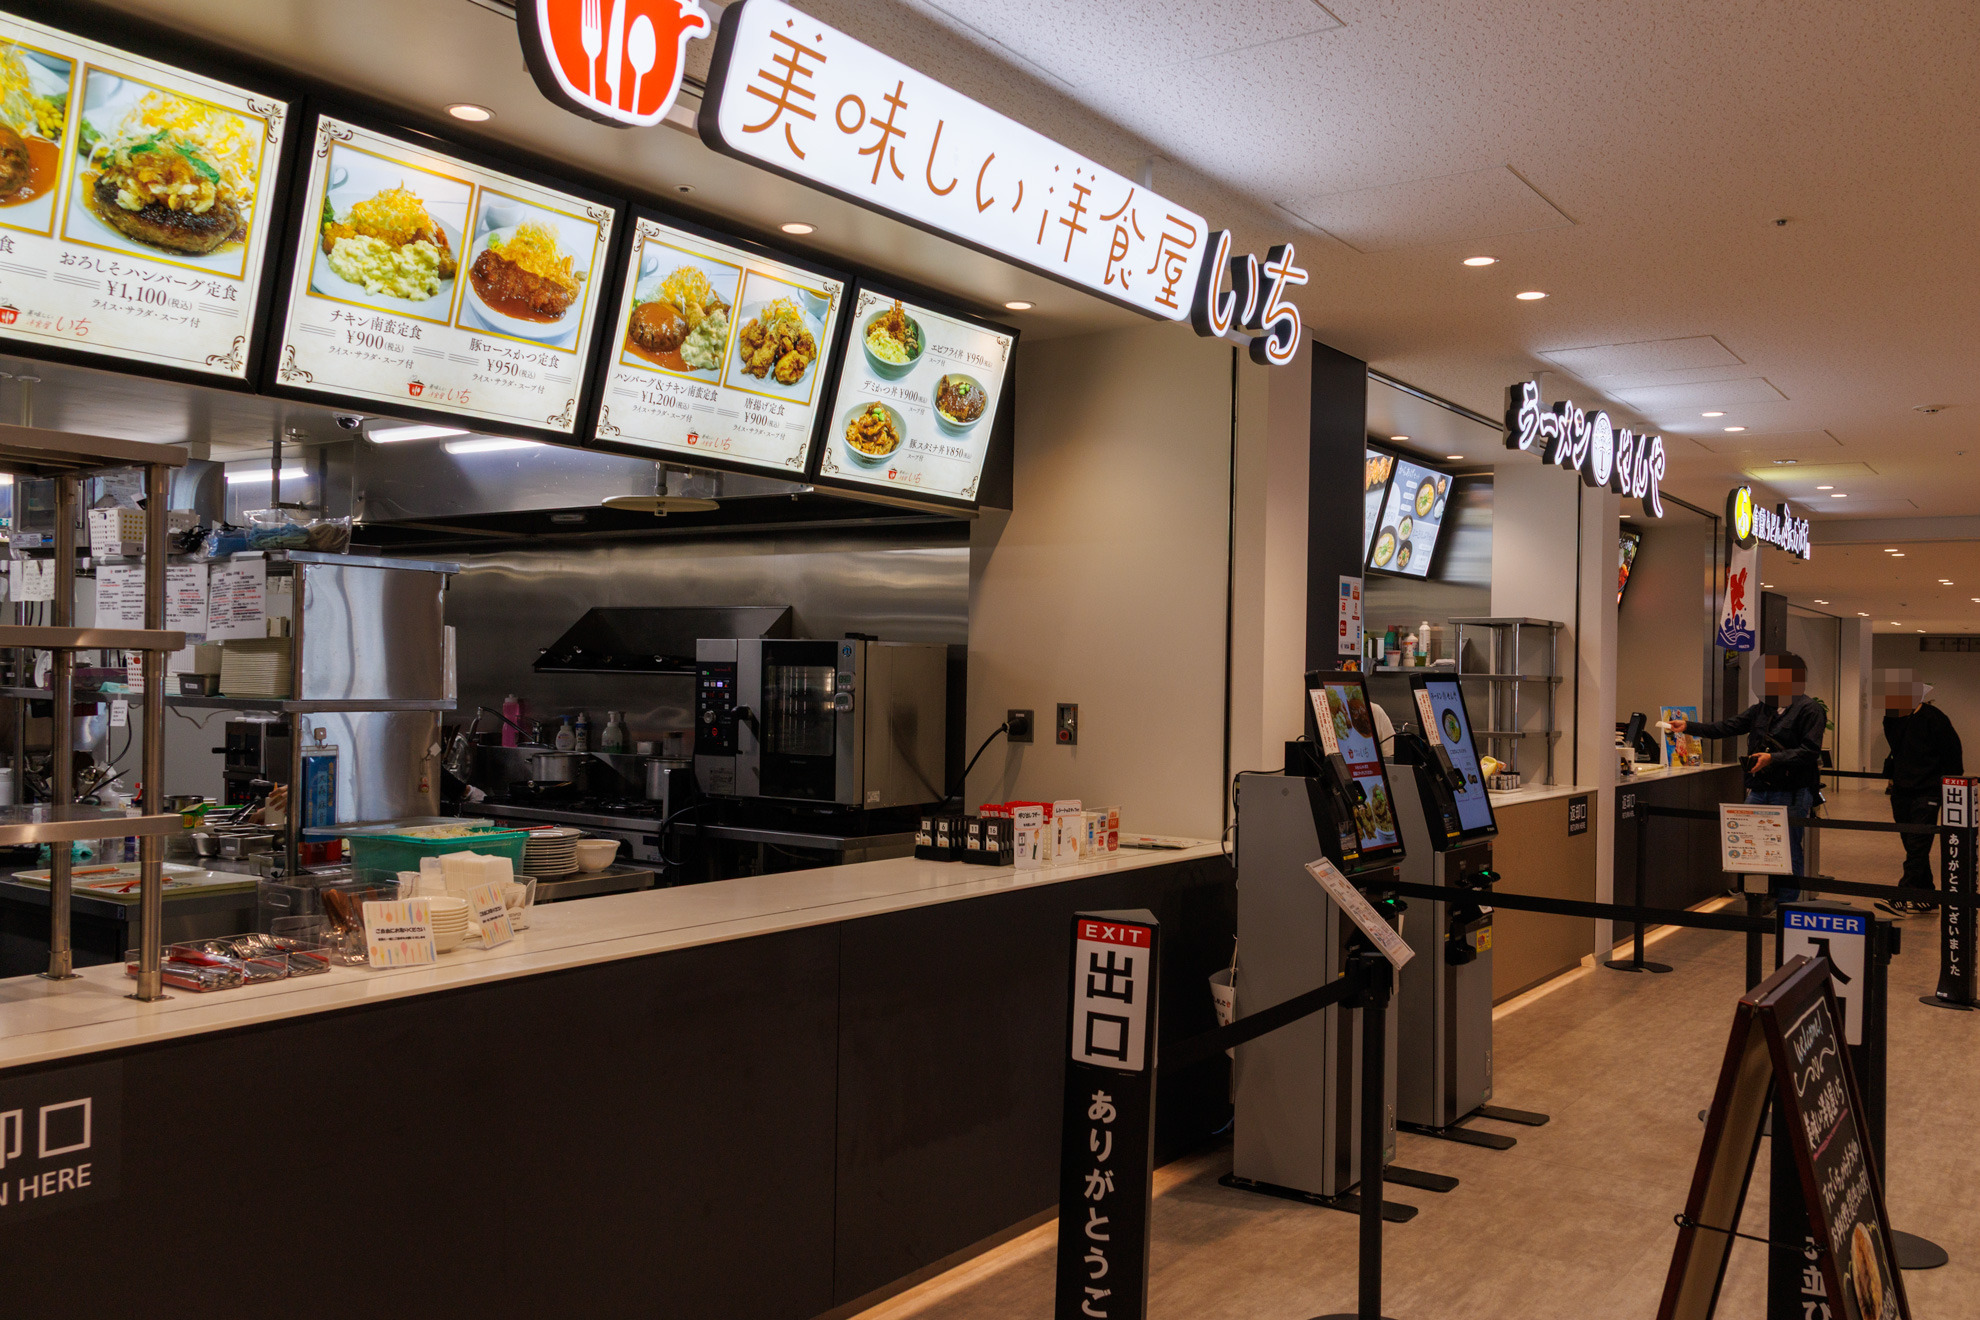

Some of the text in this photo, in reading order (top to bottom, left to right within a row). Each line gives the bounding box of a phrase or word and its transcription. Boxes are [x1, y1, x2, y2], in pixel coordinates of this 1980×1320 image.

[742, 18, 1309, 367] 美味しい洋食屋 いち
[60, 251, 239, 302] おろしそハンバーグ定食
[92, 299, 201, 329] ライス・サラダ・スープ付
[330, 308, 423, 341] チキン南蛮定食
[56, 316, 92, 337] いち
[328, 345, 415, 370] ライス・サラダ・スープ付
[468, 337, 560, 369] 豚ロースかつ定食
[931, 344, 964, 359] エビフライ丼
[472, 373, 546, 395] ライス・サラダ・スープ付
[864, 380, 898, 396] デミかつ丼
[447, 388, 472, 404] いち
[744, 397, 785, 416] 唐揚げ定食
[909, 438, 945, 455] 豚スタミナ丼
[1518, 380, 1666, 518] ラーメン せんや
[1570, 803, 1586, 821] 返却口
[1947, 788, 1963, 825] 出口
[1085, 923, 1142, 943] EXIT
[1790, 913, 1859, 932] ENTER
[1084, 950, 1134, 1062] 出口
[19, 1163, 92, 1202] HERE
